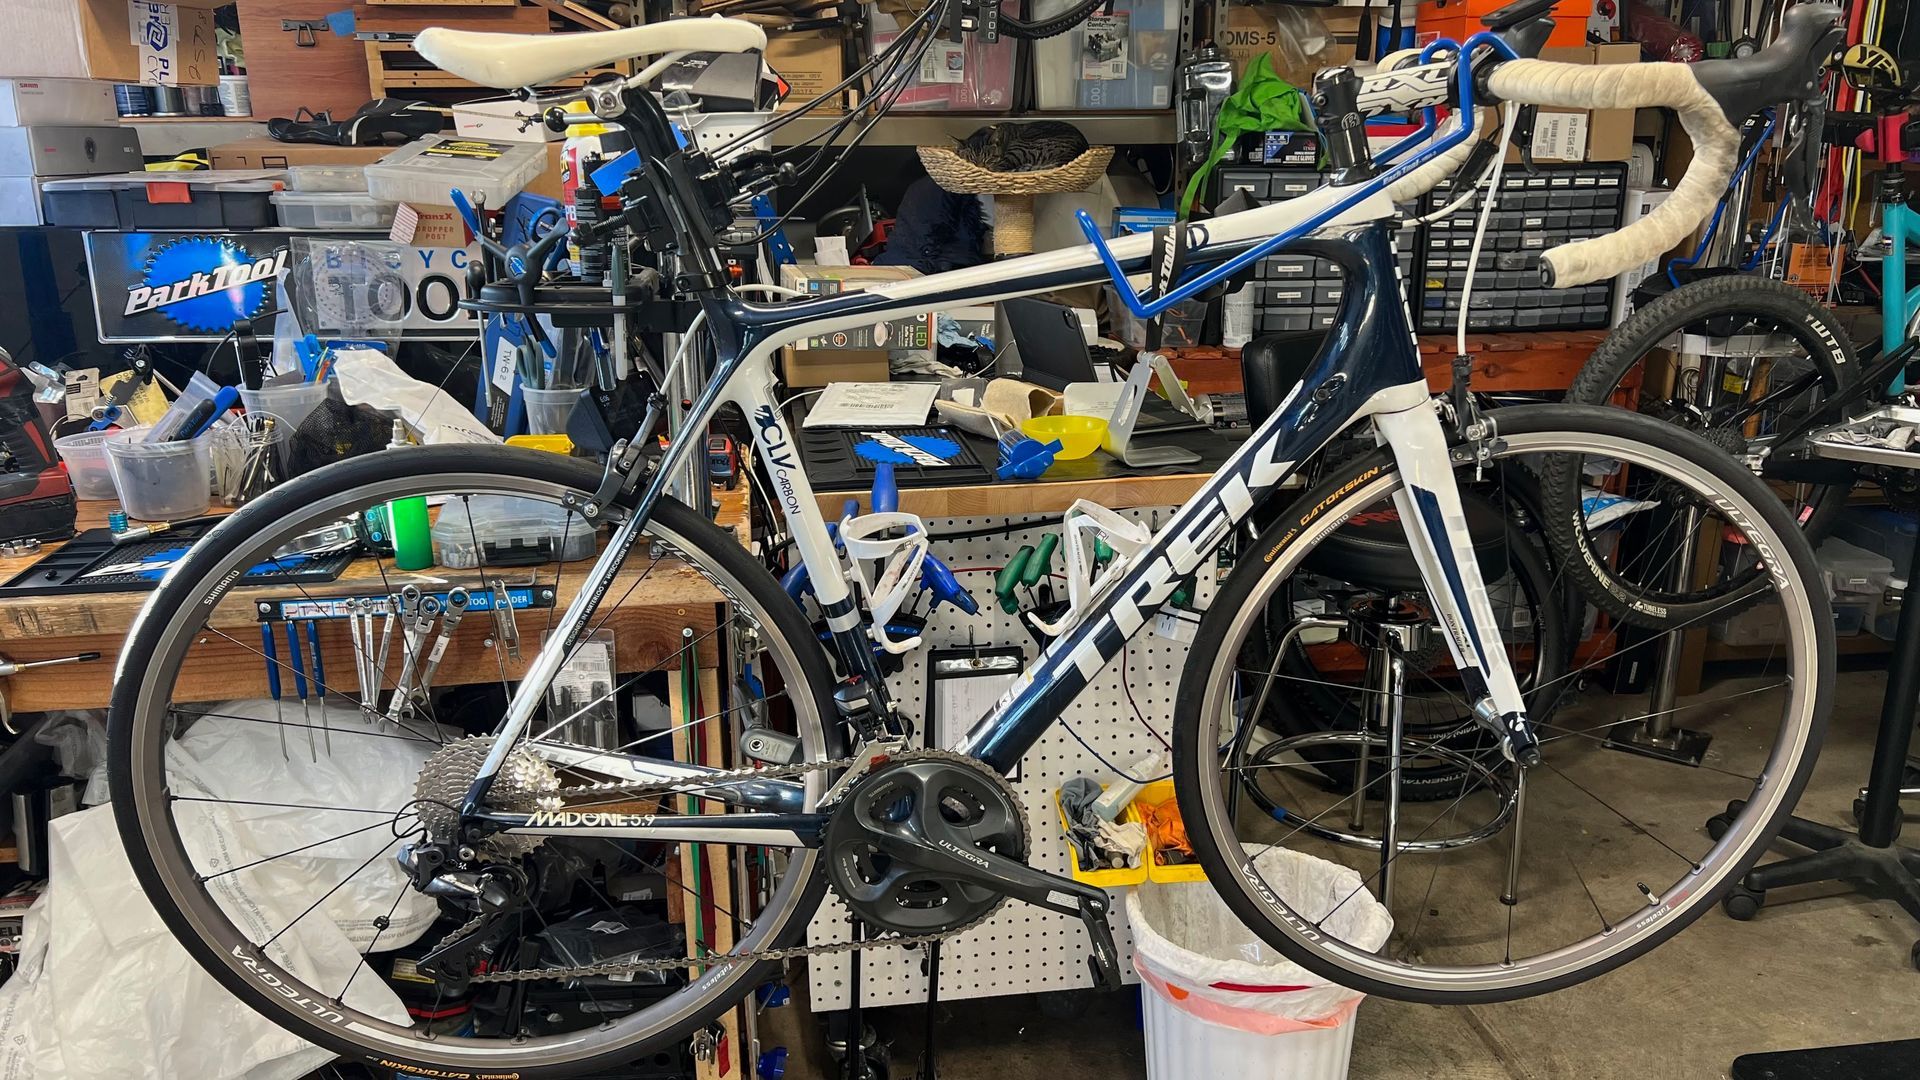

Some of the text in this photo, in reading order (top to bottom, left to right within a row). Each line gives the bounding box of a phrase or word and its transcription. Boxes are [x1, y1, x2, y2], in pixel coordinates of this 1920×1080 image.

[124, 249, 288, 316] ParkTool
[916, 325, 927, 347] LED
[1811, 320, 1846, 364] WTB
[776, 468, 801, 514] CARBON
[1300, 466, 1379, 526] GATORSKIN
[1311, 513, 1350, 546] SHIMANO
[1572, 508, 1610, 589] WOLVERINE
[1715, 498, 1790, 590] ULTEGRA
[1052, 428, 1296, 682] TREK
[203, 570, 240, 606] SHIMANO
[566, 619, 585, 647] DESIGNED
[585, 586, 605, 617] WATERLOO
[606, 548, 628, 580] WISCONSIN
[628, 530, 638, 542] USA
[655, 539, 761, 630] ULTEGRA
[1643, 603, 1667, 616] TUBELESS
[525, 810, 655, 827] MADONE 5.9
[938, 839, 989, 869] ULTEGRA
[1242, 863, 1320, 941] ULTEGRA
[1636, 904, 1671, 929] Tubeless
[231, 945, 344, 1027] ULTEGRA
[702, 962, 733, 991] Tubeless
[379, 1058, 471, 1080] GATORSKIN
